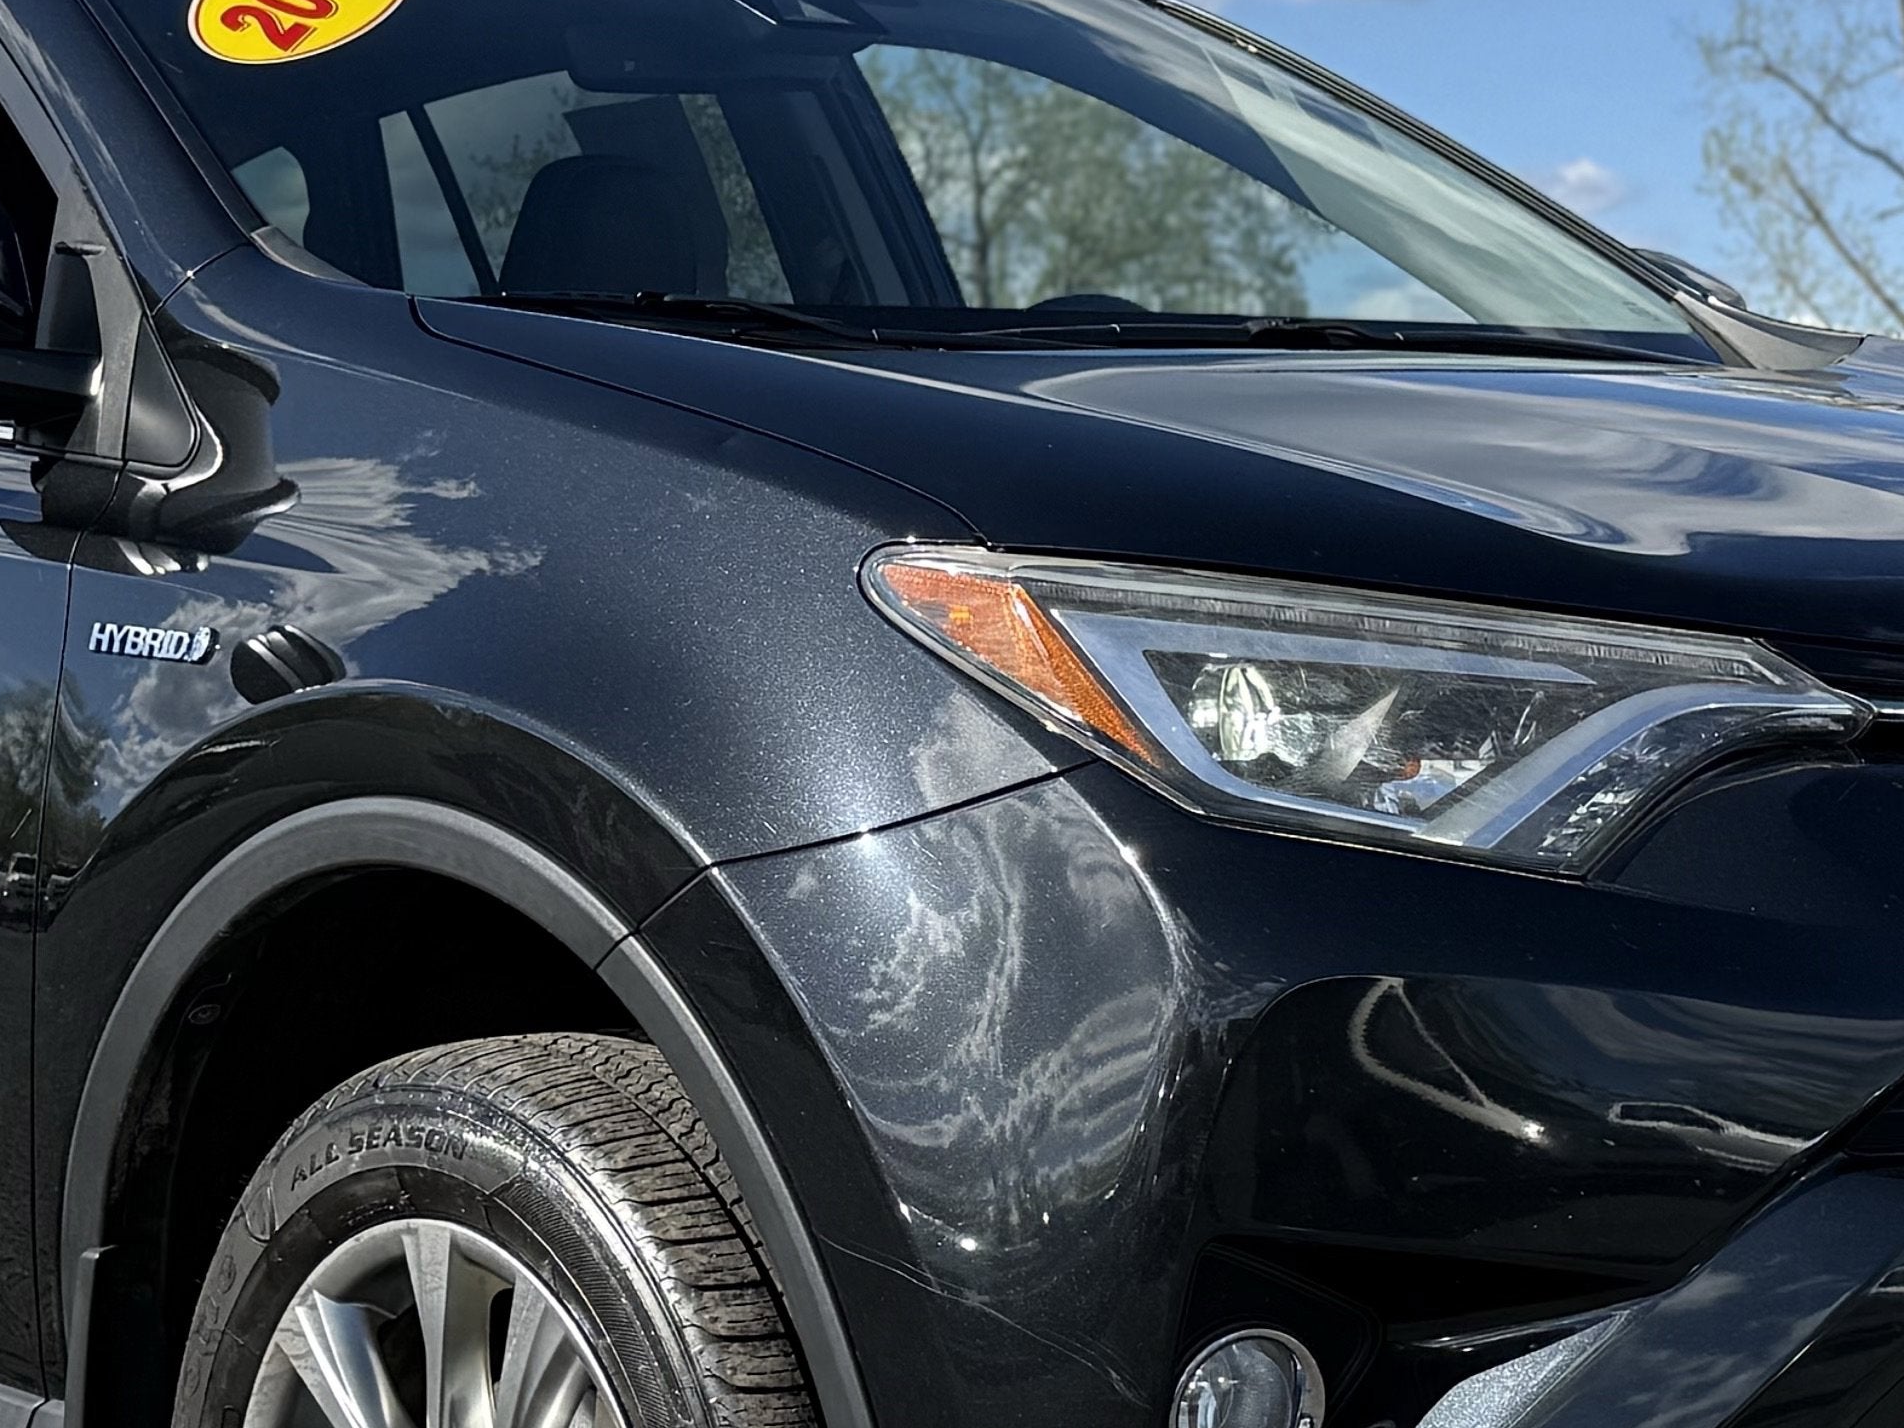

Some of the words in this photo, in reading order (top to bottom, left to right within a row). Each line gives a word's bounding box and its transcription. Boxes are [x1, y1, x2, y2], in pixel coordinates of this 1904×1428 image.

[89, 622, 189, 660] HYBRID
[291, 1141, 341, 1192] ALL
[348, 1123, 467, 1161] SEASON
